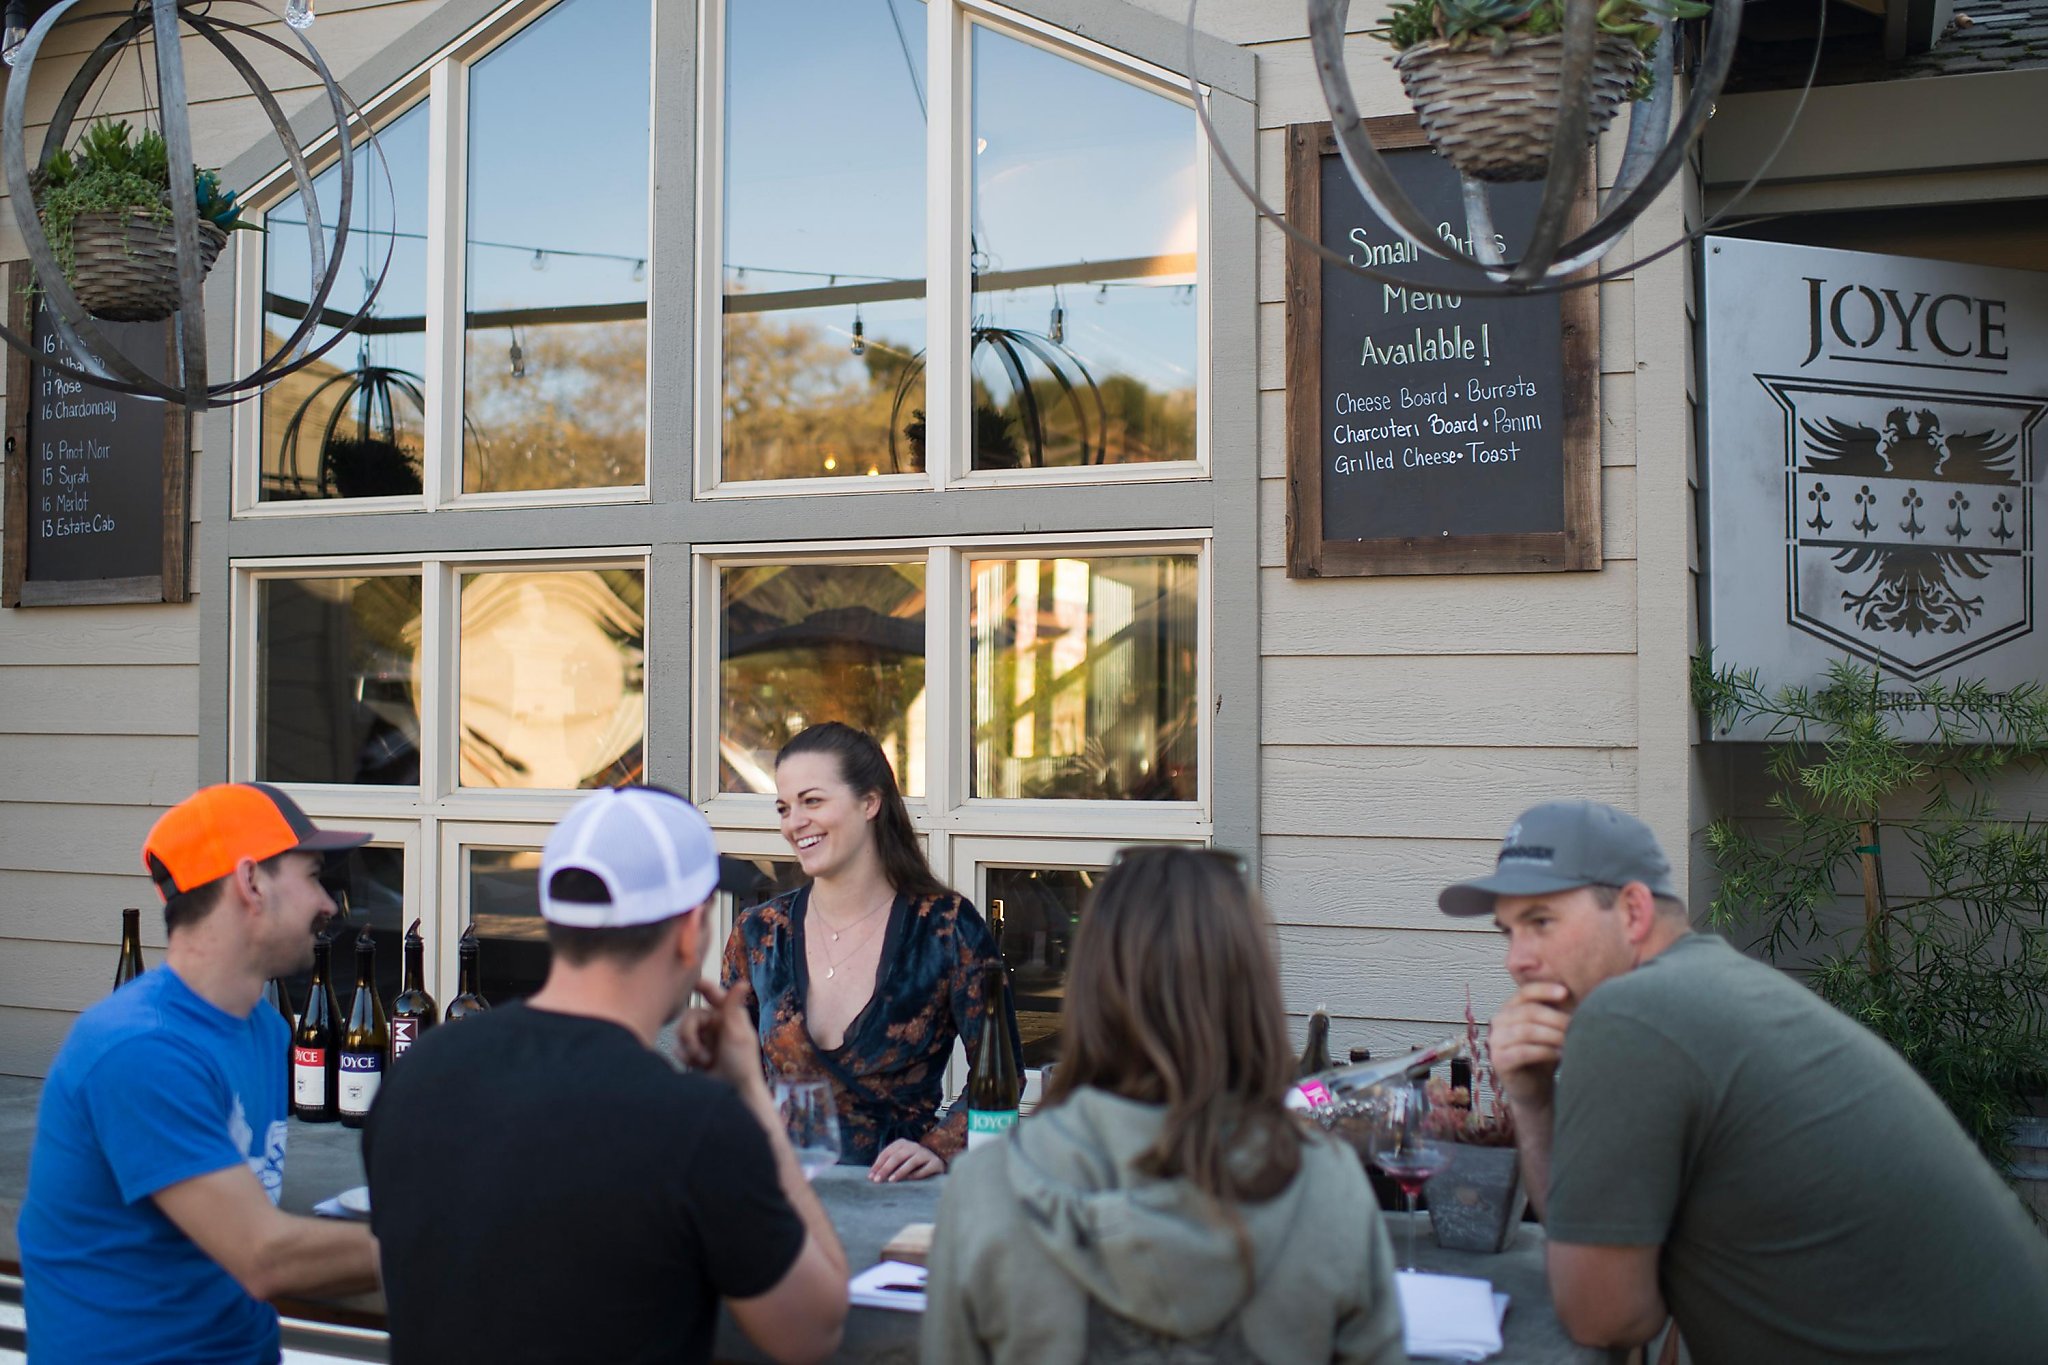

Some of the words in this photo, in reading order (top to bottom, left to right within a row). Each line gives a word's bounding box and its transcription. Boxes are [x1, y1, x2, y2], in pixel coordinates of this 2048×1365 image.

[1348, 227, 1419, 268] Small
[1437, 221, 1507, 257] Bits
[1382, 283, 1463, 314] Menu
[1801, 277, 2009, 368] JOYCE
[43, 333, 55, 354] 16
[43, 381, 52, 397] 17
[1335, 391, 1391, 416] Cheese
[1400, 386, 1448, 408] Board
[1467, 375, 1537, 400] Burrata
[42, 404, 53, 420] 16
[55, 398, 117, 422] Chardonnay
[1428, 415, 1479, 436] Board
[1493, 407, 1543, 434] Panini
[42, 443, 54, 461] 16
[59, 439, 84, 460] Pinot
[88, 438, 111, 460] Noir
[1334, 446, 1394, 476] Grilled
[1465, 441, 1521, 465] Toast
[42, 467, 53, 486] 15
[59, 465, 90, 493] Syrah
[42, 496, 52, 512] 16
[56, 491, 89, 512] Merlot
[42, 519, 54, 538] 13
[56, 516, 91, 536] Estate
[92, 513, 115, 533] Cab
[395, 1022, 412, 1058] ME
[340, 1054, 375, 1069] JOYCE
